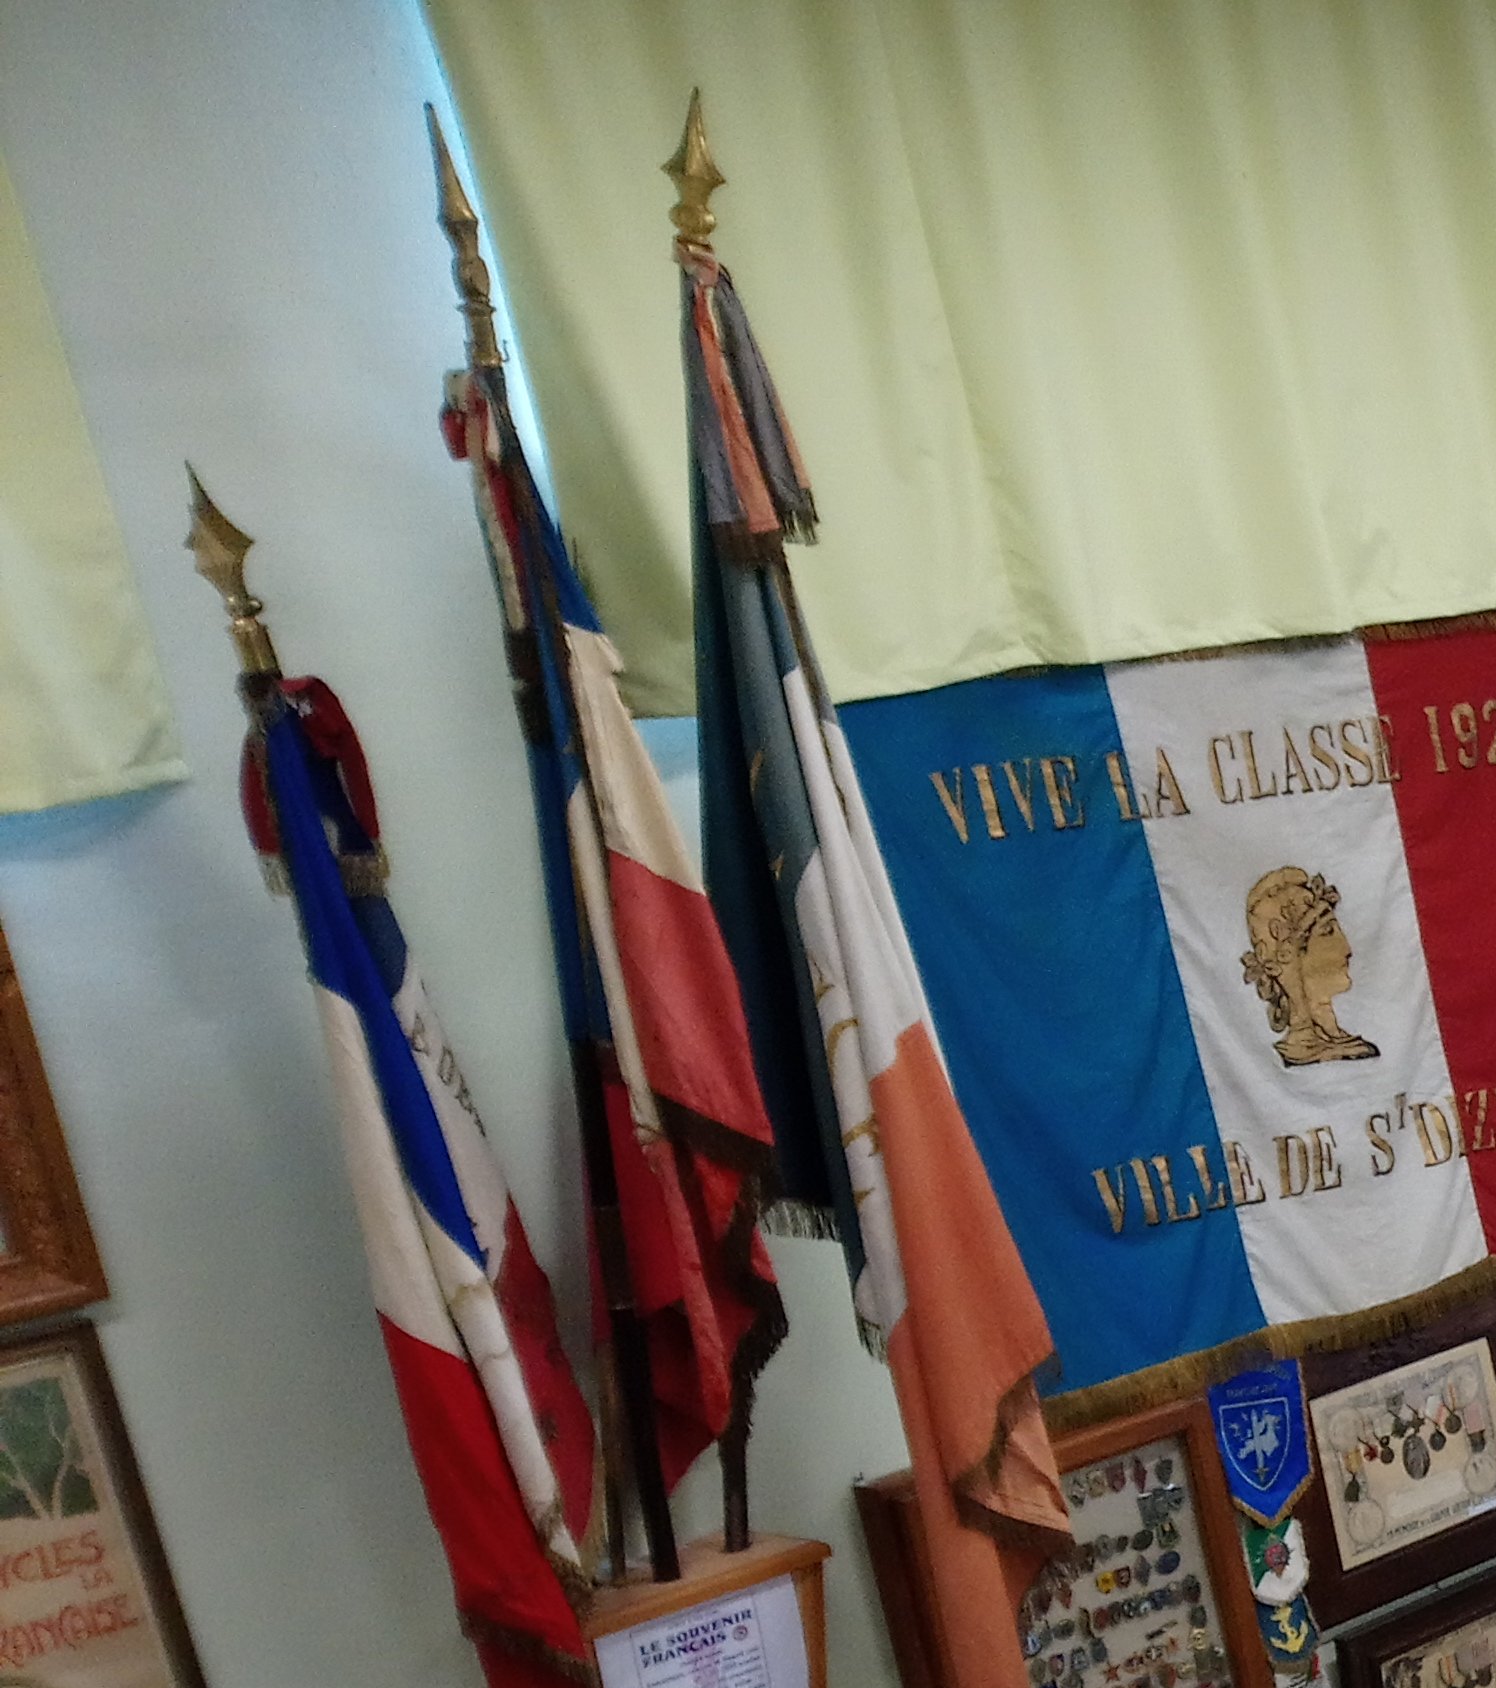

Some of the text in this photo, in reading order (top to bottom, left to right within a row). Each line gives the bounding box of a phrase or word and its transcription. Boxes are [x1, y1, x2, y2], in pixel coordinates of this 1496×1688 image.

[928, 753, 1089, 845] VIVE
[1107, 747, 1191, 822] LA
[1206, 711, 1404, 806] CLASSE
[1091, 1140, 1267, 1234] VILLE
[1274, 1126, 1343, 1199] DE
[639, 1639, 664, 1657] LE
[665, 1608, 754, 1646] SOUVENIR
